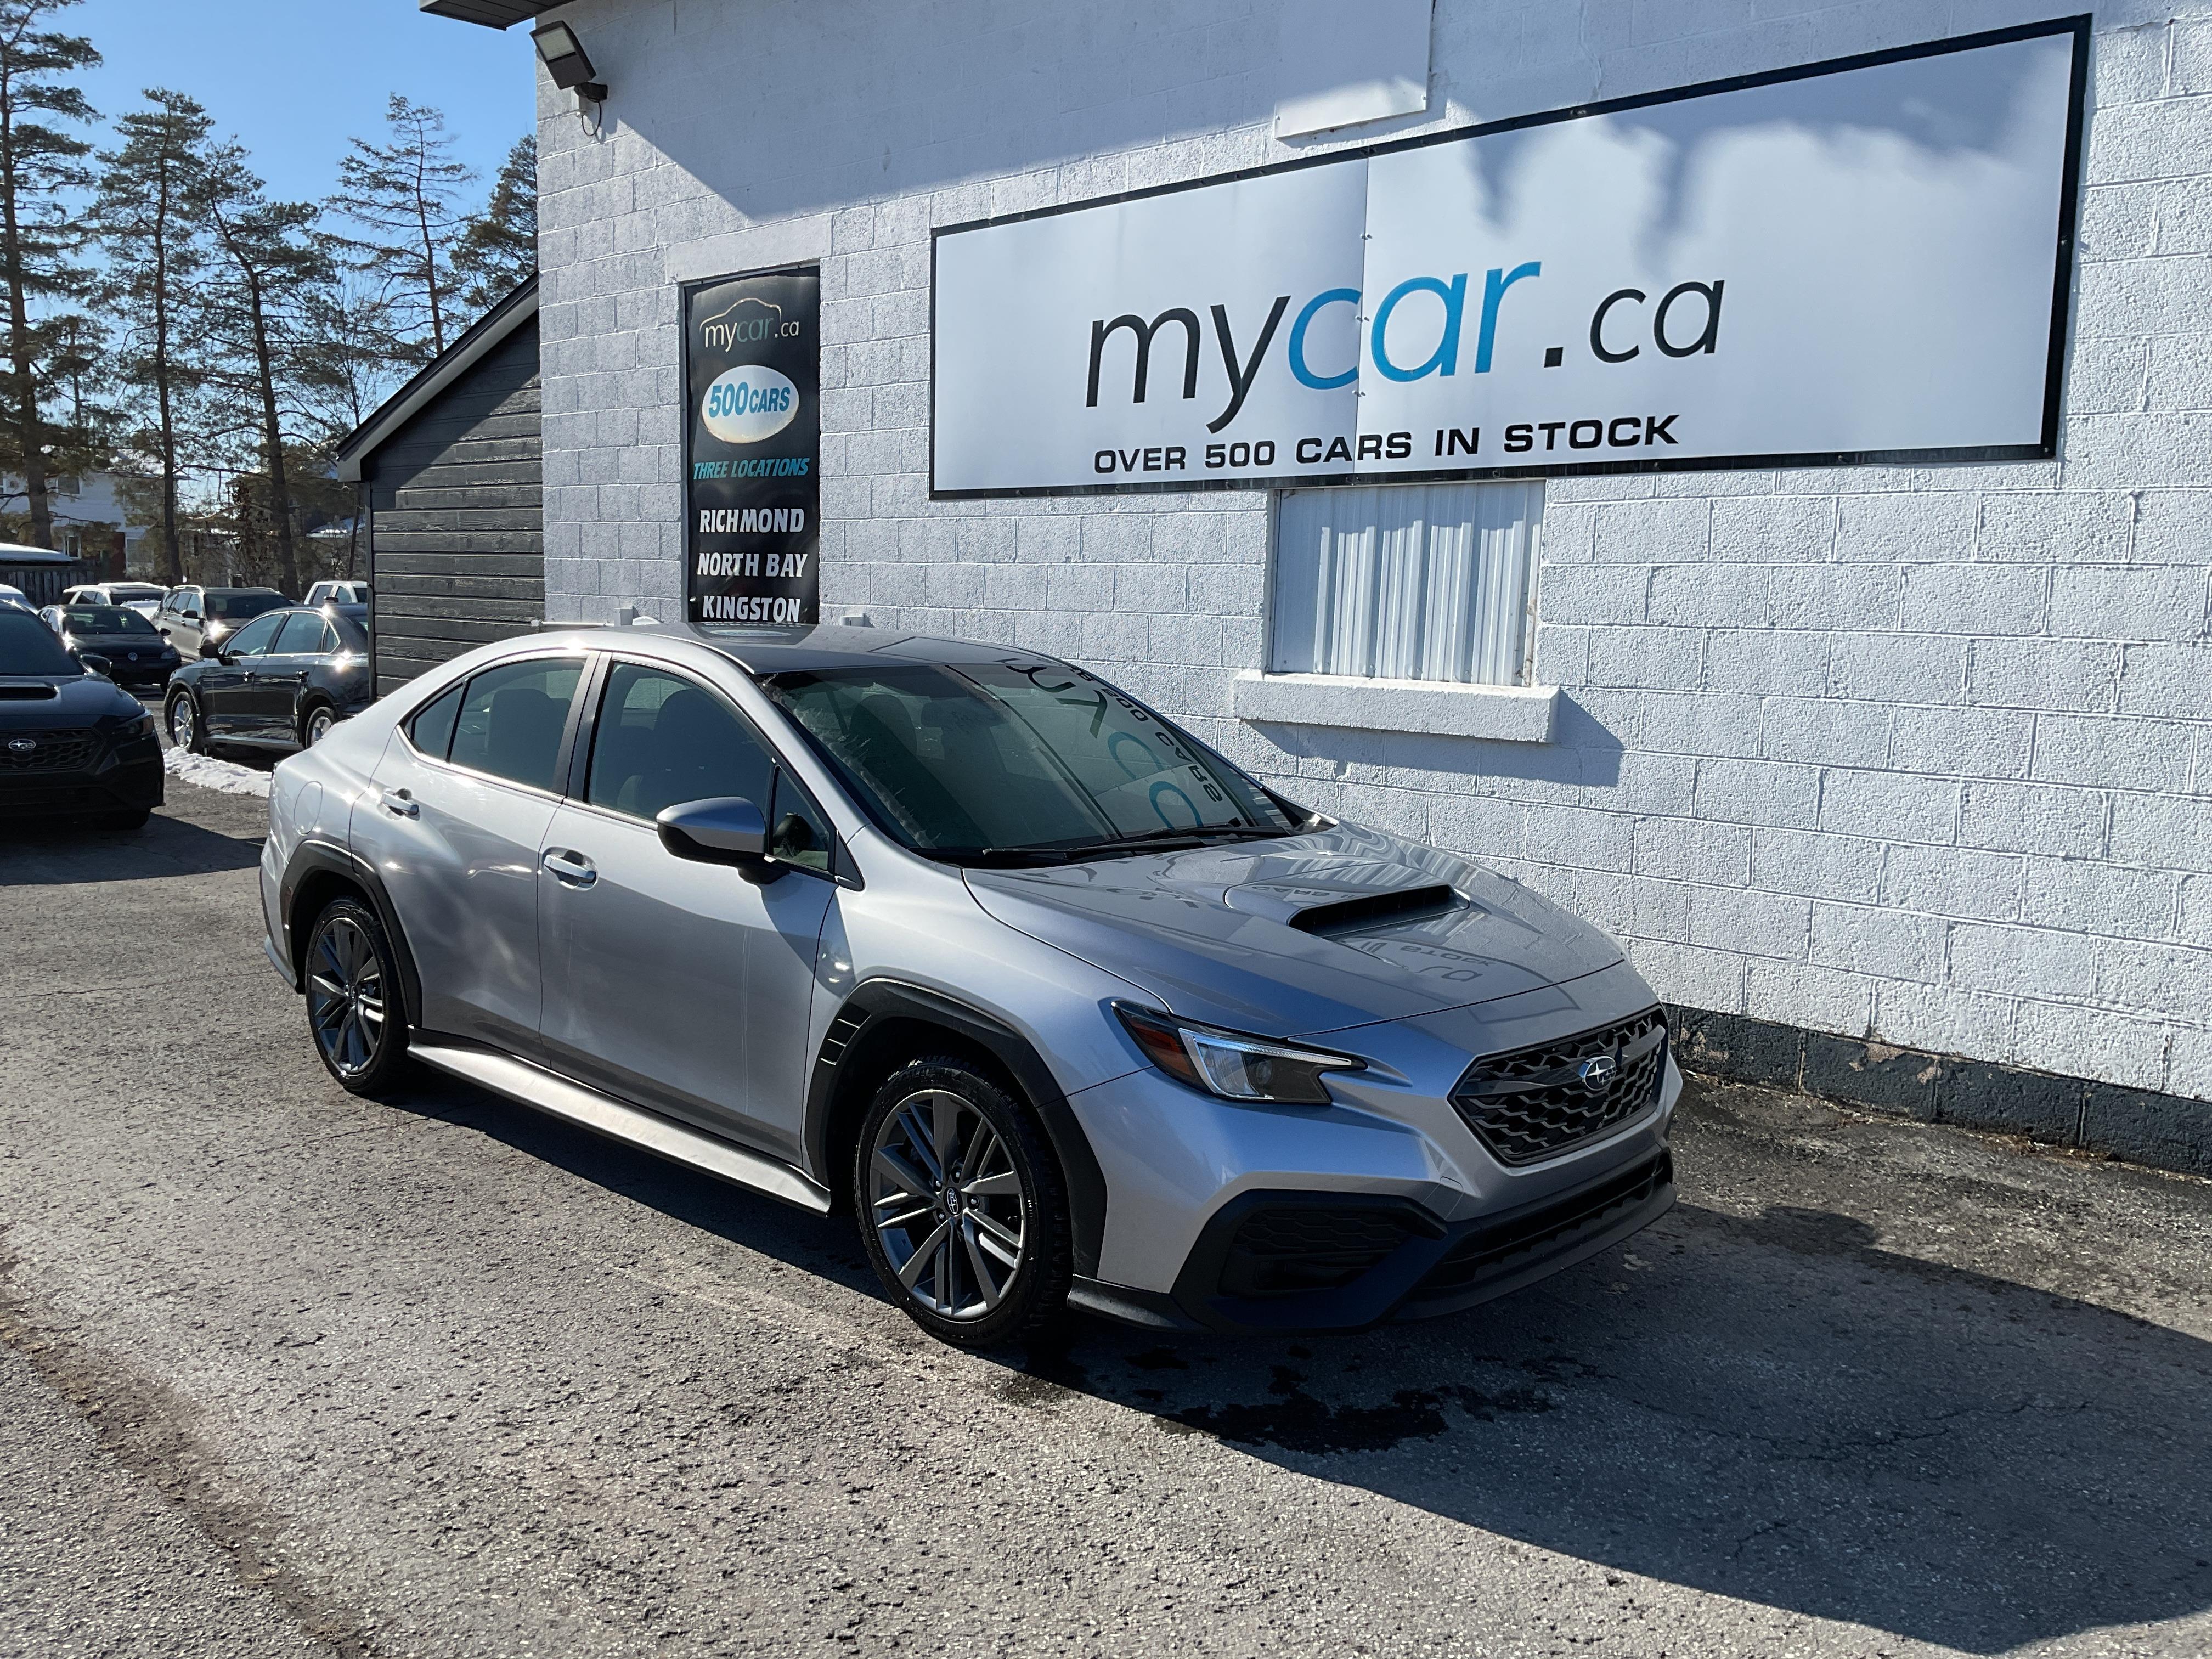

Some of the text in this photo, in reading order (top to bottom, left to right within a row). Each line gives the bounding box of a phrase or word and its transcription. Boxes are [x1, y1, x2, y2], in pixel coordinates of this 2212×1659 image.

[705, 317, 799, 353] mycar.ca
[1086, 261, 1725, 434] mycar.ca
[1094, 415, 1680, 473] OVER 500 CARS IN STOCK
[693, 458, 810, 480] THREE LOCATIONS
[699, 508, 805, 533] RICHMOND
[697, 552, 808, 577] NORTH BAY
[702, 595, 801, 623] KINGSTON
